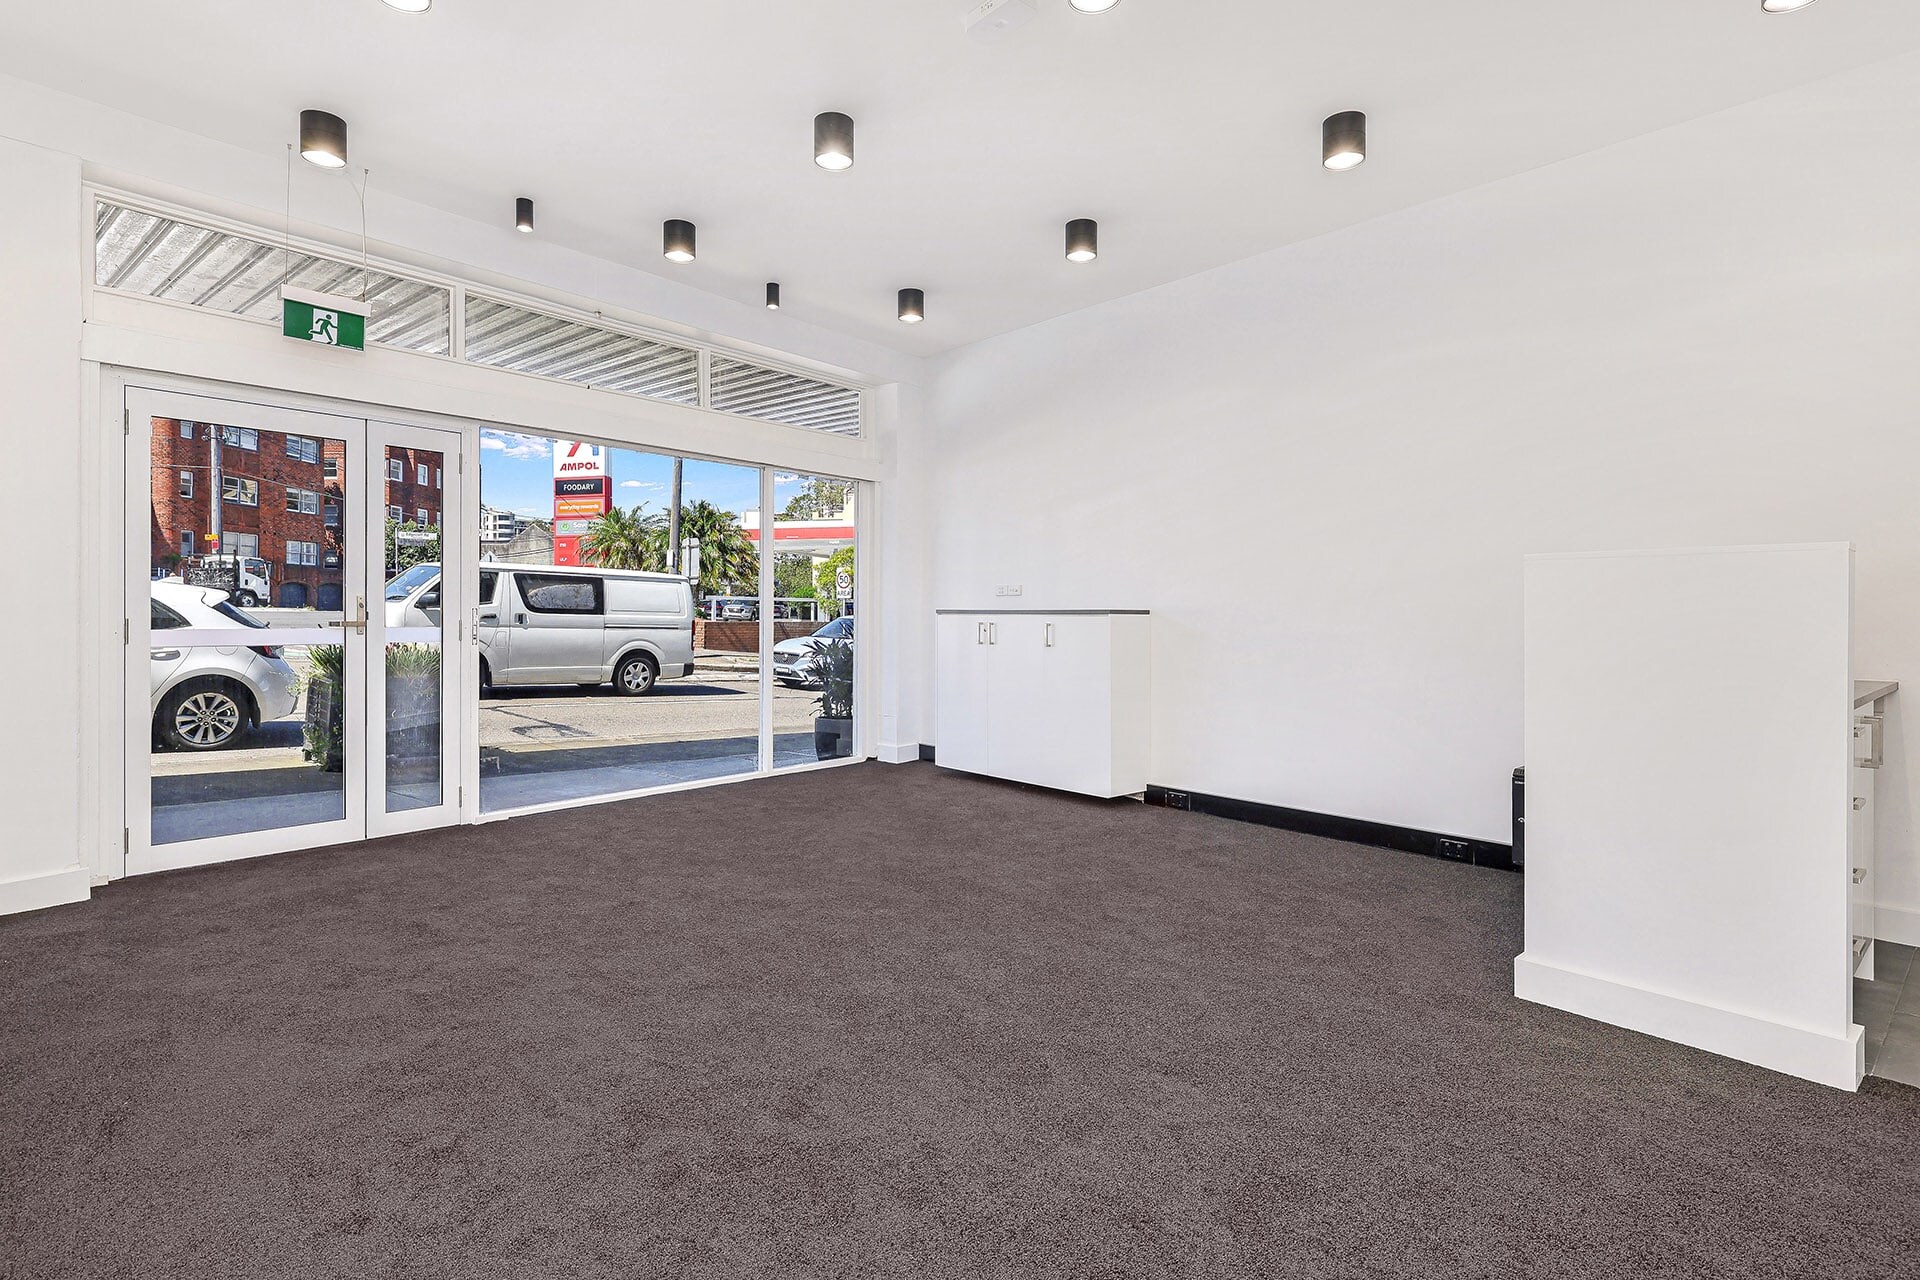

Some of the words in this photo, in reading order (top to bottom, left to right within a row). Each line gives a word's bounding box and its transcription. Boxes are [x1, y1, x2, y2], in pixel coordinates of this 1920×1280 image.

[559, 462, 599, 471] AMPOL
[563, 483, 594, 491] FOODARY
[840, 576, 848, 584] 50
